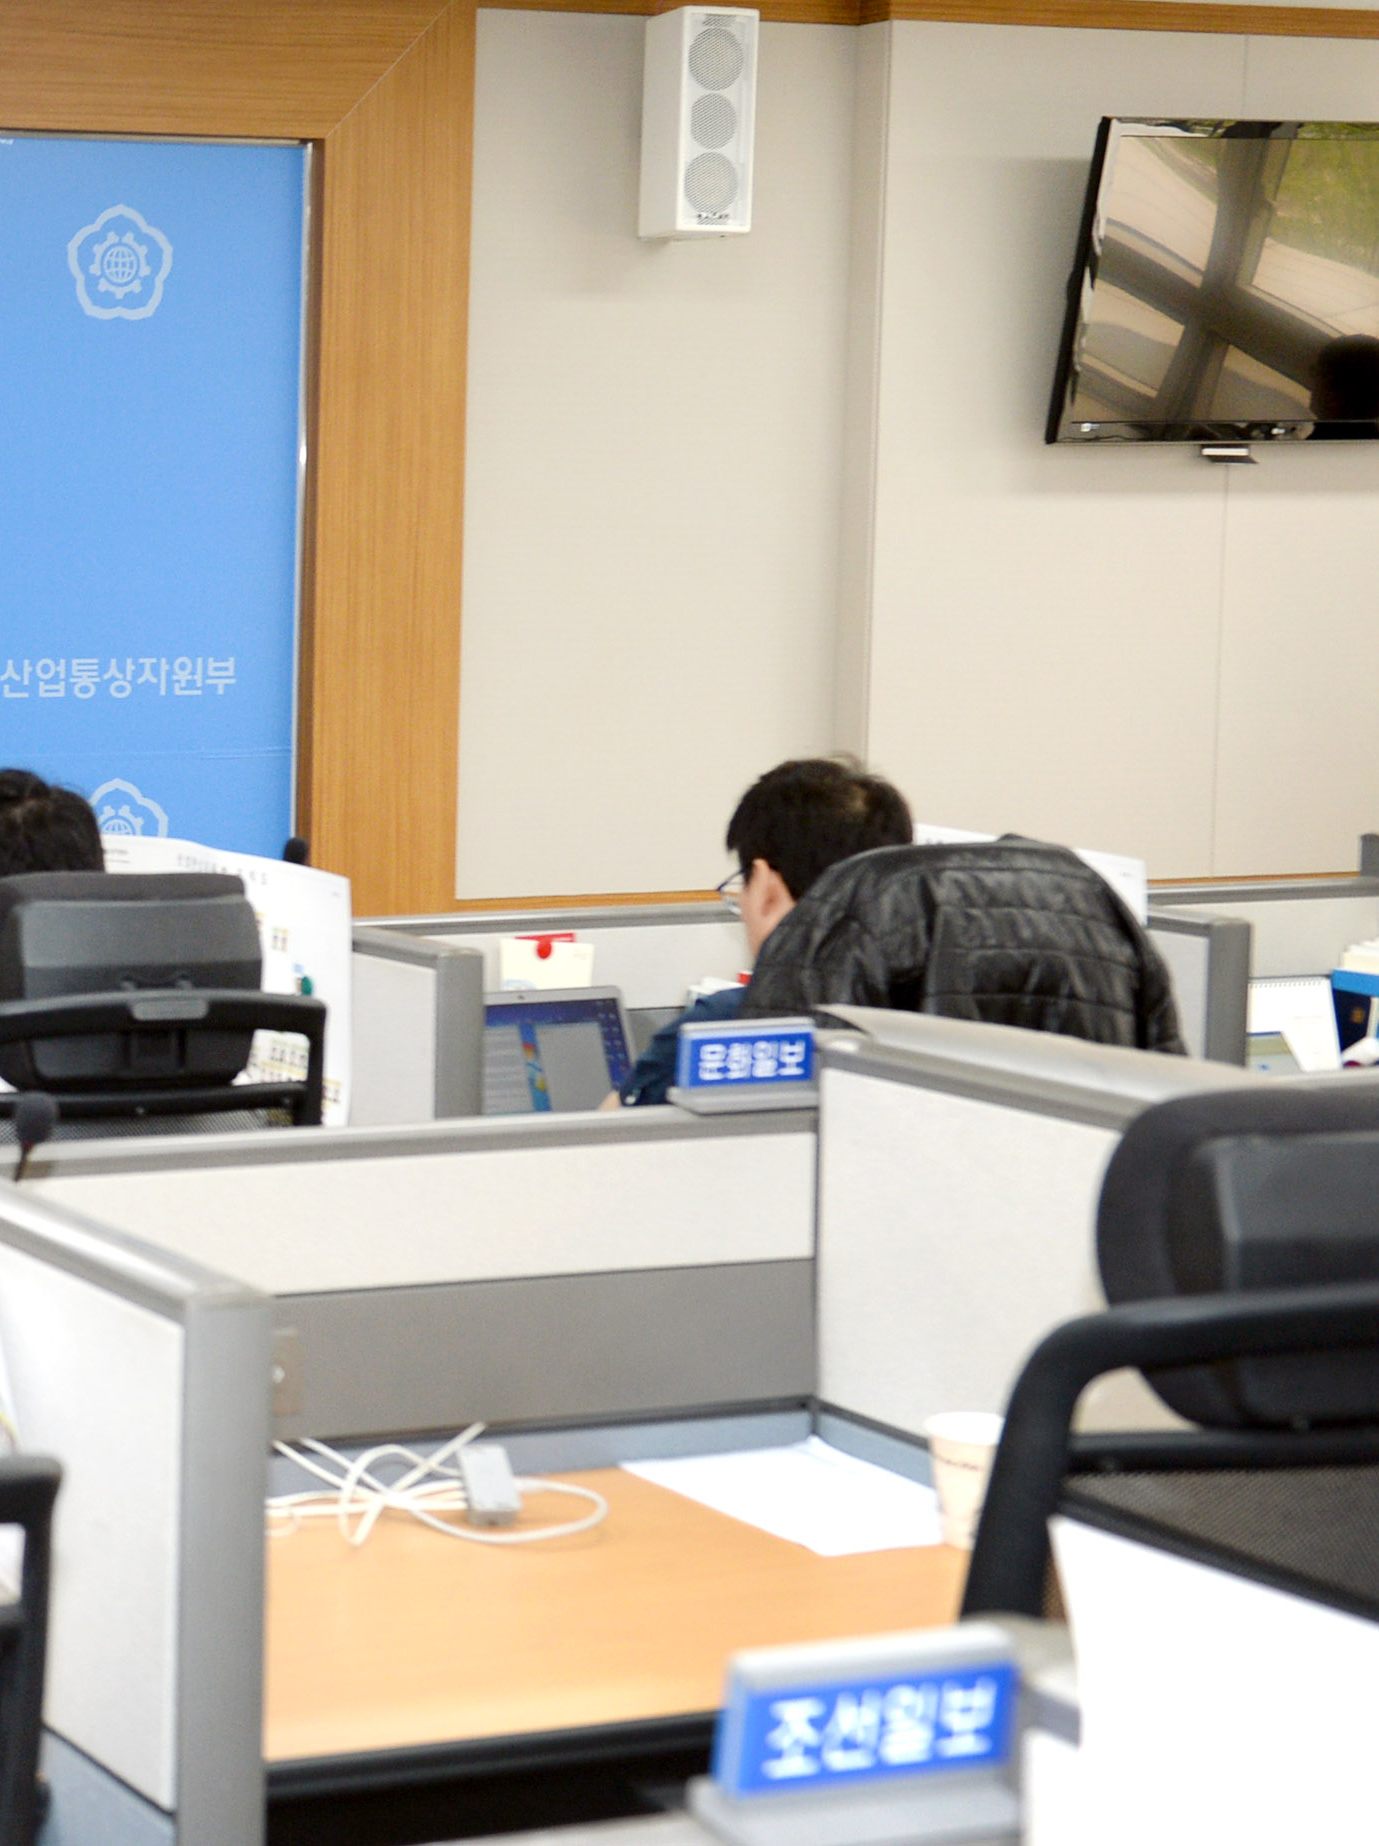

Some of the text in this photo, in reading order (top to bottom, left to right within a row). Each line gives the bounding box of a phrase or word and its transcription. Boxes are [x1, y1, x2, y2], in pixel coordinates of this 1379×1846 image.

[0, 655, 237, 699] 산업통상자원부
[698, 1040, 806, 1081] 문화일보
[761, 1675, 998, 1780] 조선일보
